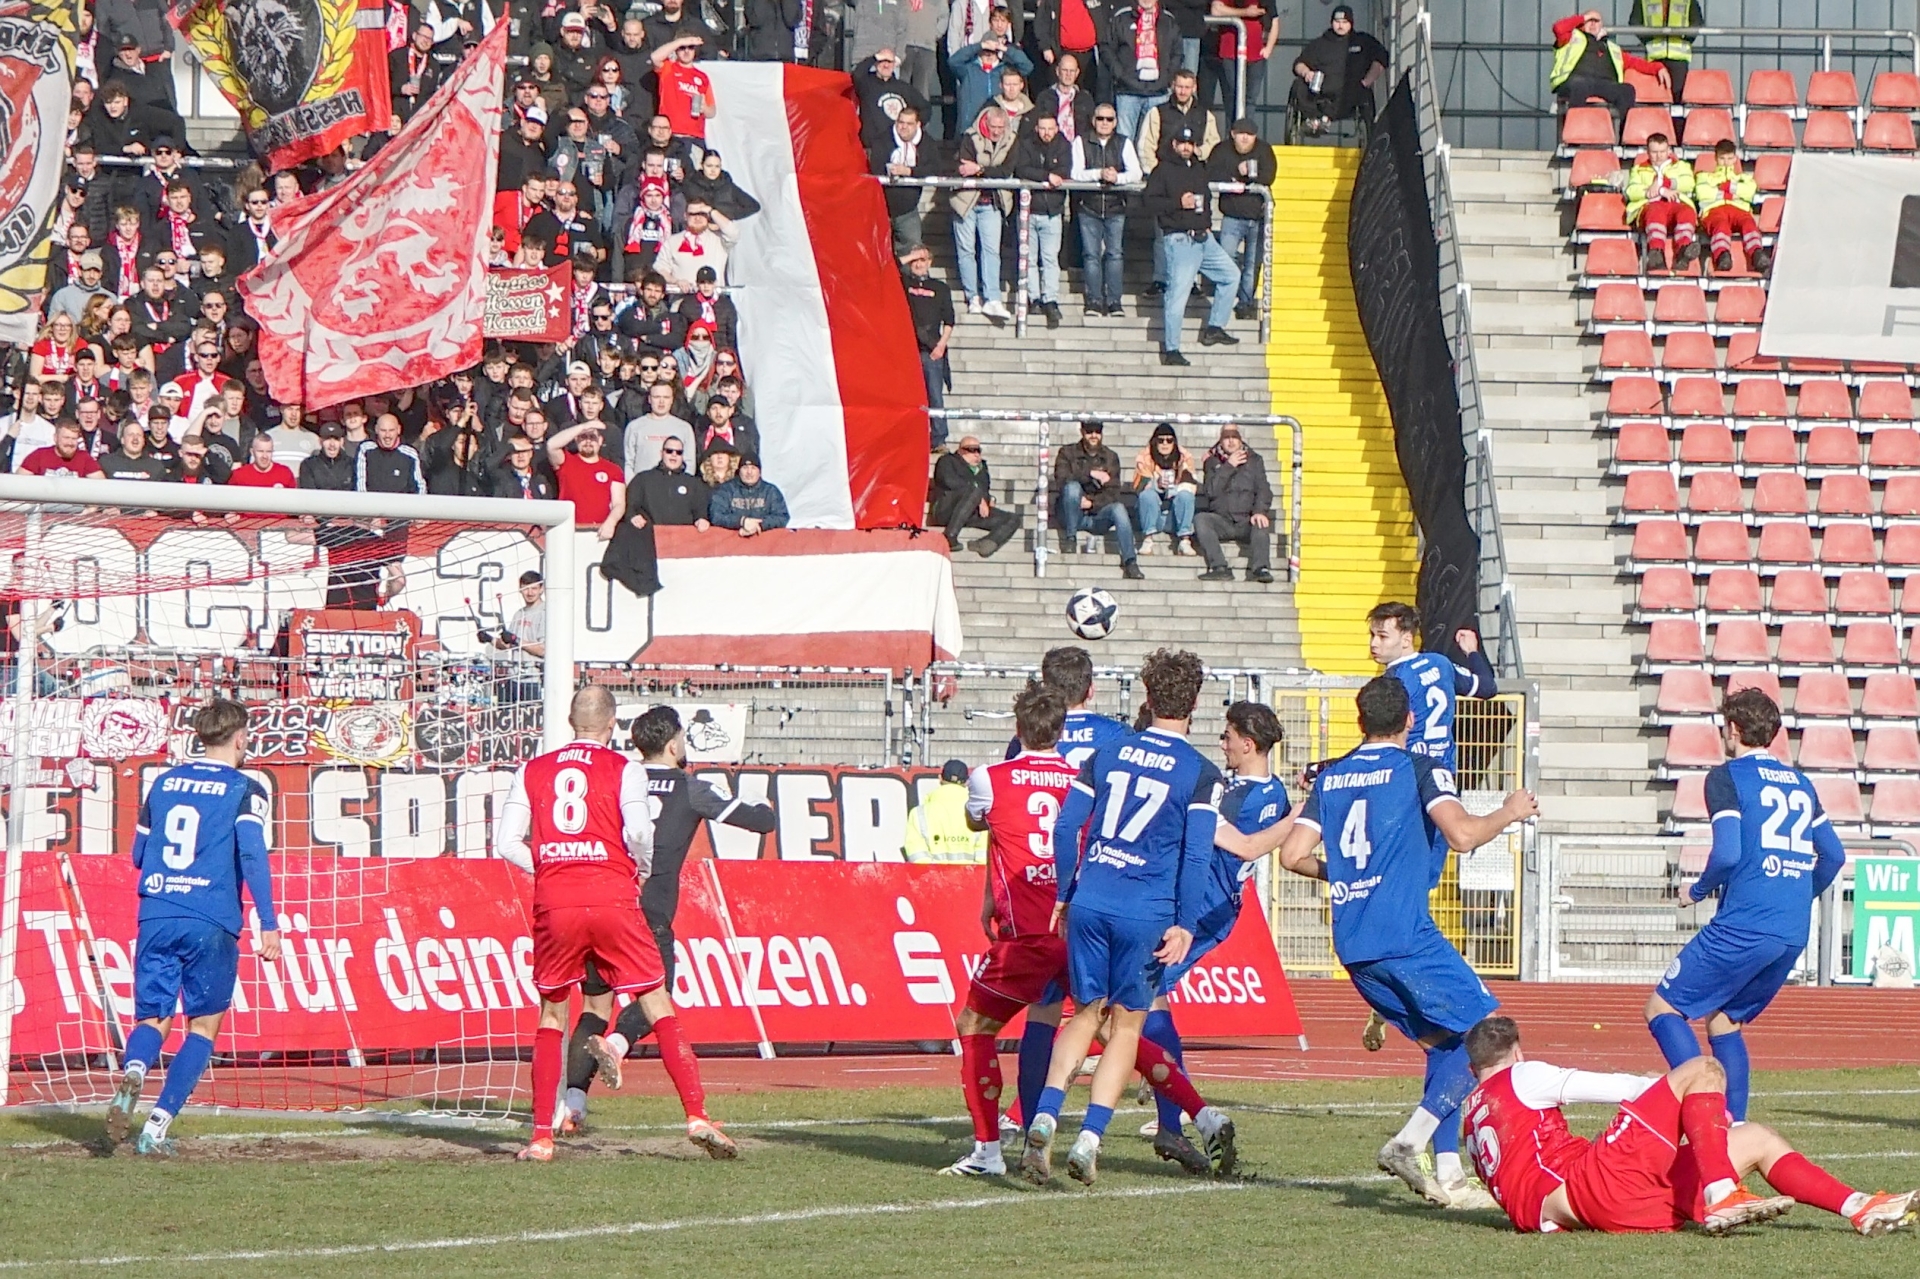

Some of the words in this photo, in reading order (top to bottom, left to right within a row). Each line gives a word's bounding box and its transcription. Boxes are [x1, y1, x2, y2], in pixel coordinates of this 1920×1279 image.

[306, 633, 403, 656] SEKTION
[1423, 685, 1448, 740] 2
[556, 749, 593, 765] BRILL
[1118, 746, 1176, 772] GARIC
[162, 776, 227, 796] SITTER
[647, 780, 676, 793] ELLI
[1011, 769, 1077, 789] SPRINGFE
[1757, 766, 1800, 785] FECHER
[552, 767, 588, 834] 8
[1100, 770, 1170, 843] 17
[1026, 791, 1061, 859] 3
[1760, 785, 1814, 855] 22
[162, 804, 201, 870] 9
[1338, 799, 1372, 869] 4
[540, 845, 608, 861] POLYMA
[1098, 854, 1126, 869] group
[165, 874, 211, 887] maintaler
[165, 884, 192, 894] group
[1865, 864, 1910, 892] Wir
[249, 906, 358, 1012] für
[374, 906, 542, 1012] deine
